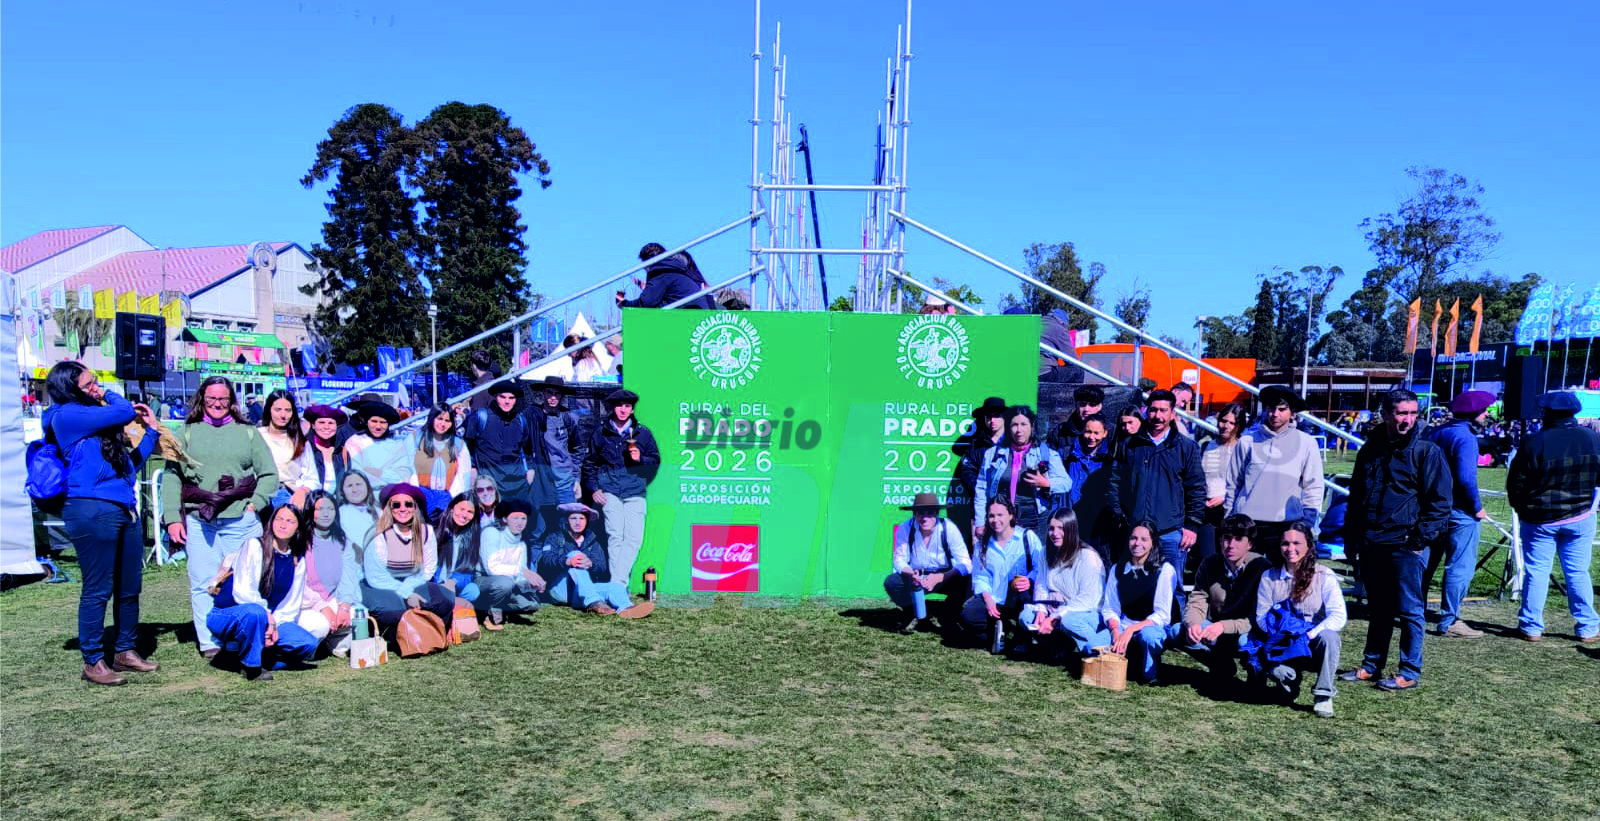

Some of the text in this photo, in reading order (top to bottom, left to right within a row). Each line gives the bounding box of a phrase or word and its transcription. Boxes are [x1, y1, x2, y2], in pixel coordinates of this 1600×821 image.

[739, 318, 762, 348] RURAL
[947, 317, 970, 348] RURAL
[689, 356, 762, 389] DEL URUGUAY
[896, 355, 970, 389] DEL URUGUAY
[679, 402, 772, 416] RURAL DEL
[884, 402, 940, 416] RURAL
[679, 417, 773, 437] PRADO
[884, 418, 977, 437] PRADO
[680, 450, 772, 472] 2026
[883, 450, 952, 472] 202
[680, 483, 771, 494] EXPOSICIÓN
[883, 483, 964, 494] EXPOSICIÓ
[680, 494, 771, 505] AGROPECUARIA
